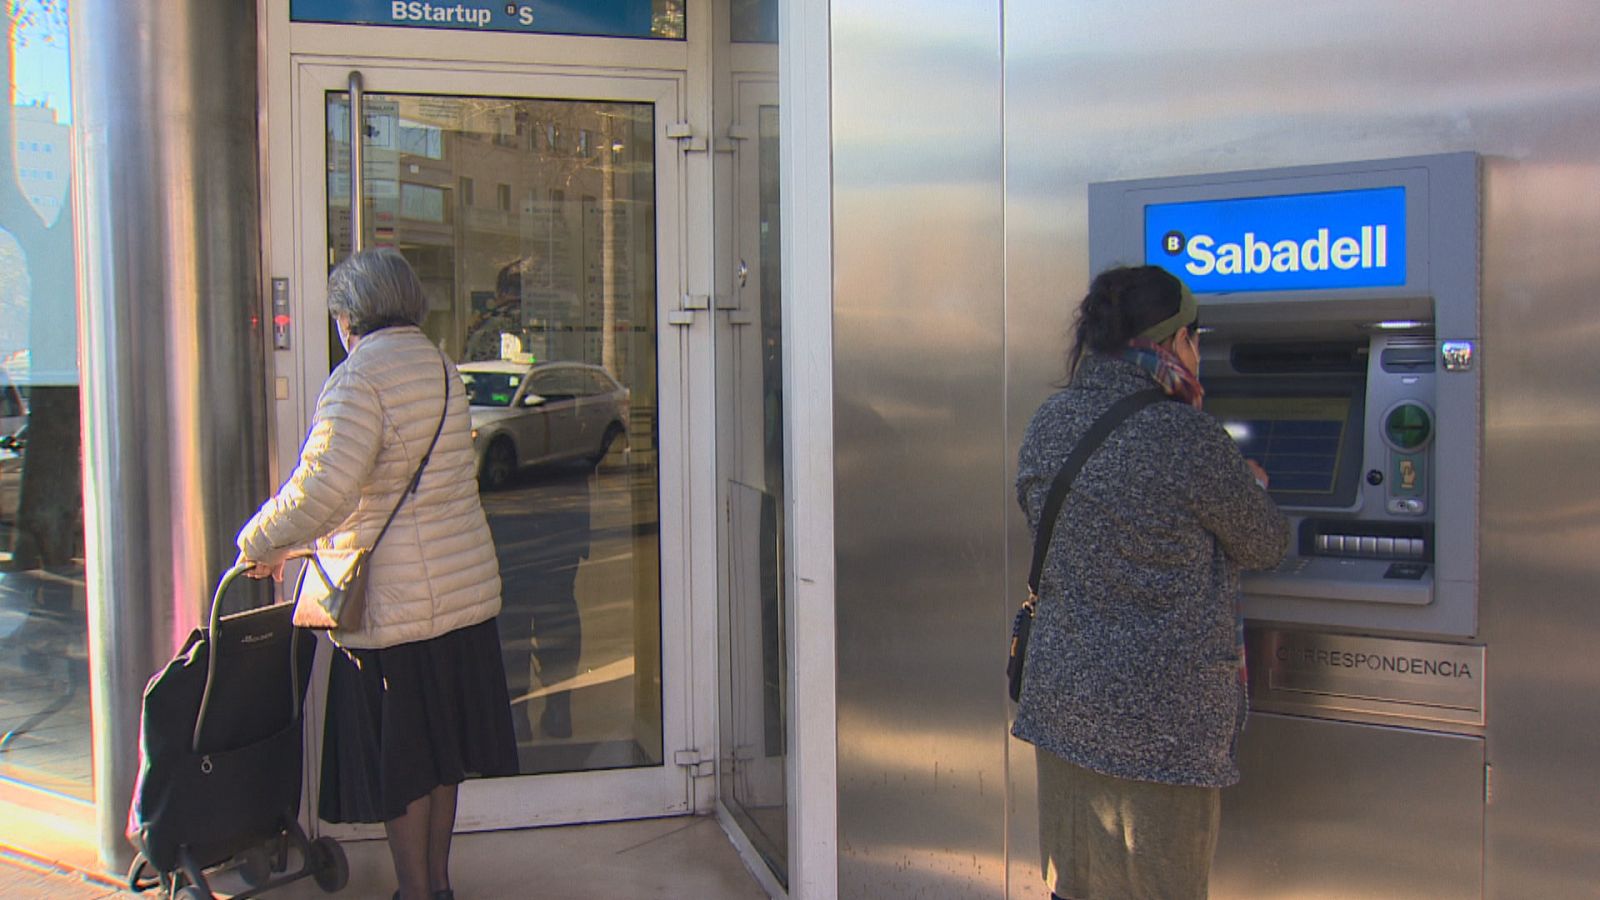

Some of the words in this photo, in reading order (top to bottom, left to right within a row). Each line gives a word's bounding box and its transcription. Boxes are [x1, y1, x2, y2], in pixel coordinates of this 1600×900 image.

[392, 1, 491, 27] BStartup
[1185, 225, 1387, 276] Sabadell
[1276, 647, 1472, 679] CRRESPONDENCIA
